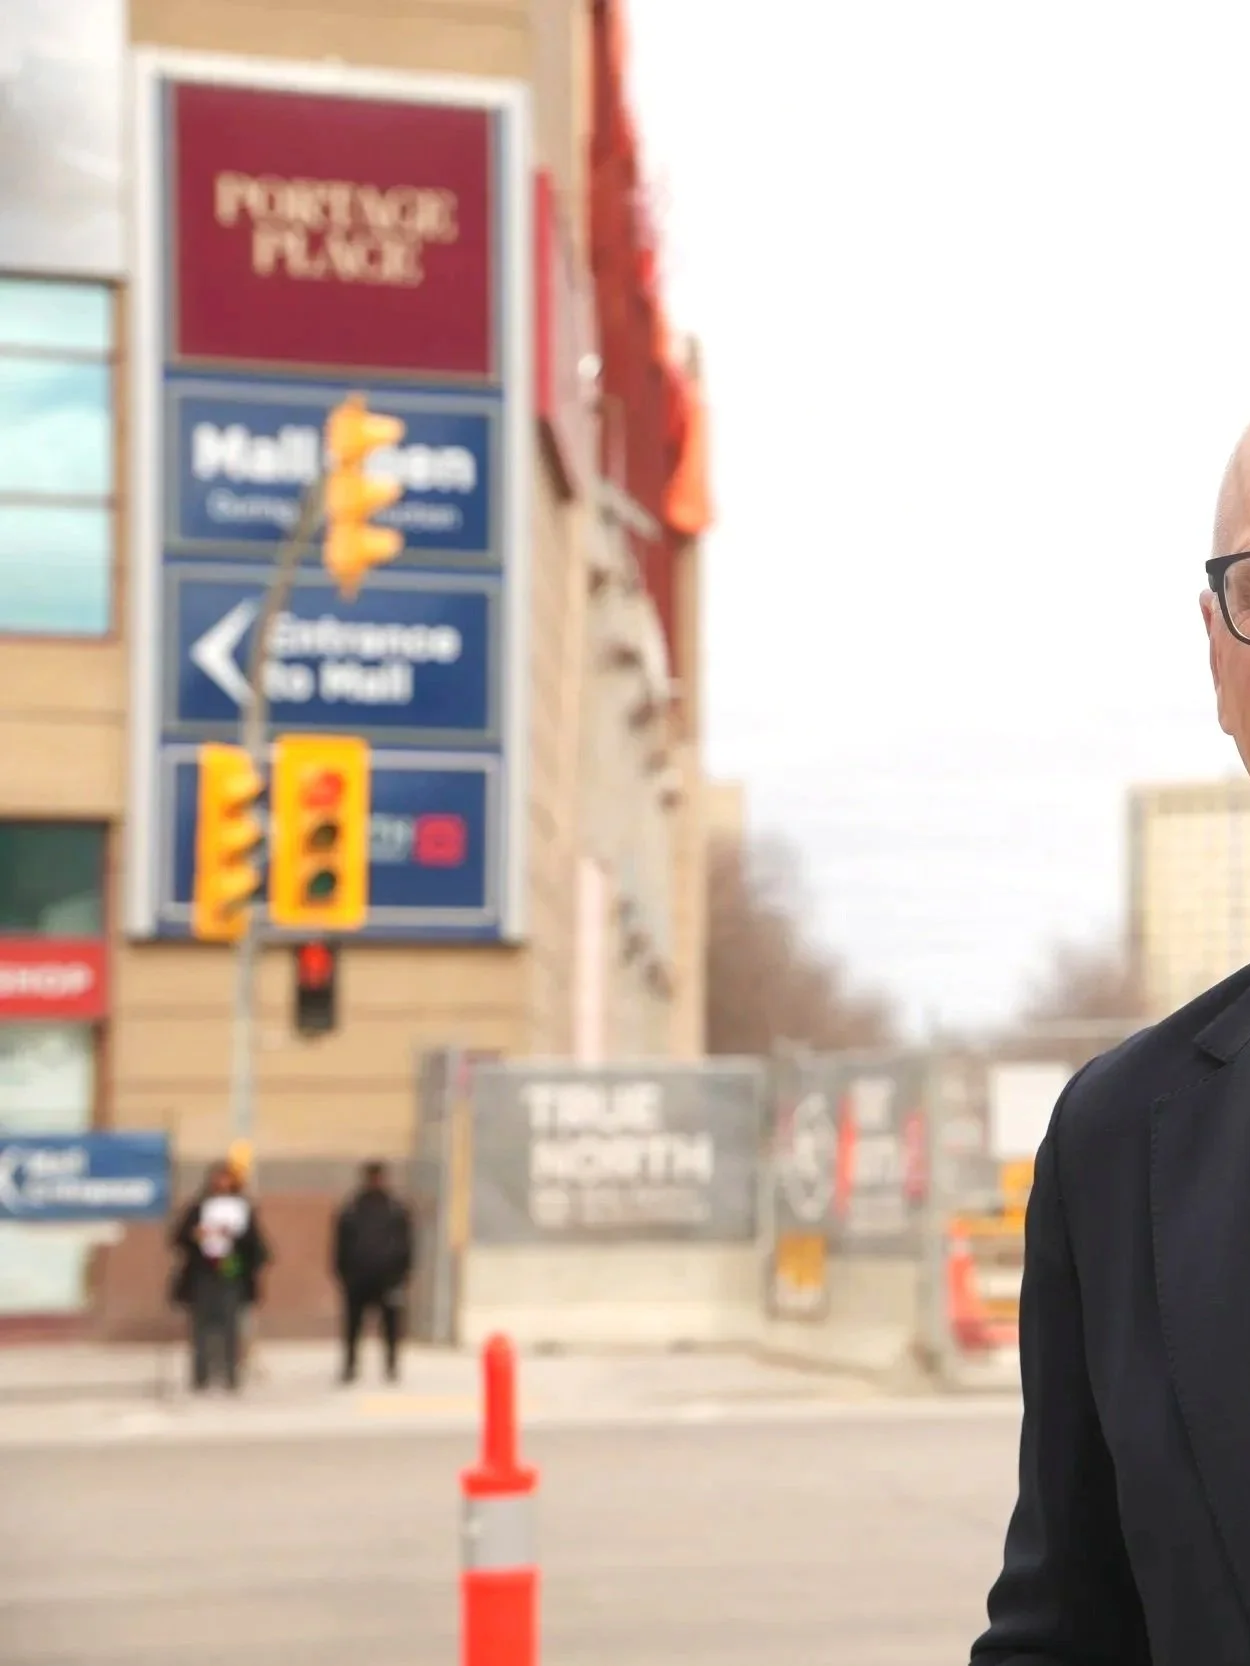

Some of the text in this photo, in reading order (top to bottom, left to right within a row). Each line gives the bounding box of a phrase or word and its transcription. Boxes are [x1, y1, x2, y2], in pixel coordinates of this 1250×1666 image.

[215, 171, 458, 242] PORTAGE
[252, 222, 423, 287] PLACE
[192, 423, 477, 493] Mall pen
[266, 614, 460, 662] Entrance
[263, 659, 414, 705] to Mall
[523, 1083, 662, 1130] TRUE
[530, 1134, 713, 1185] NORTH
